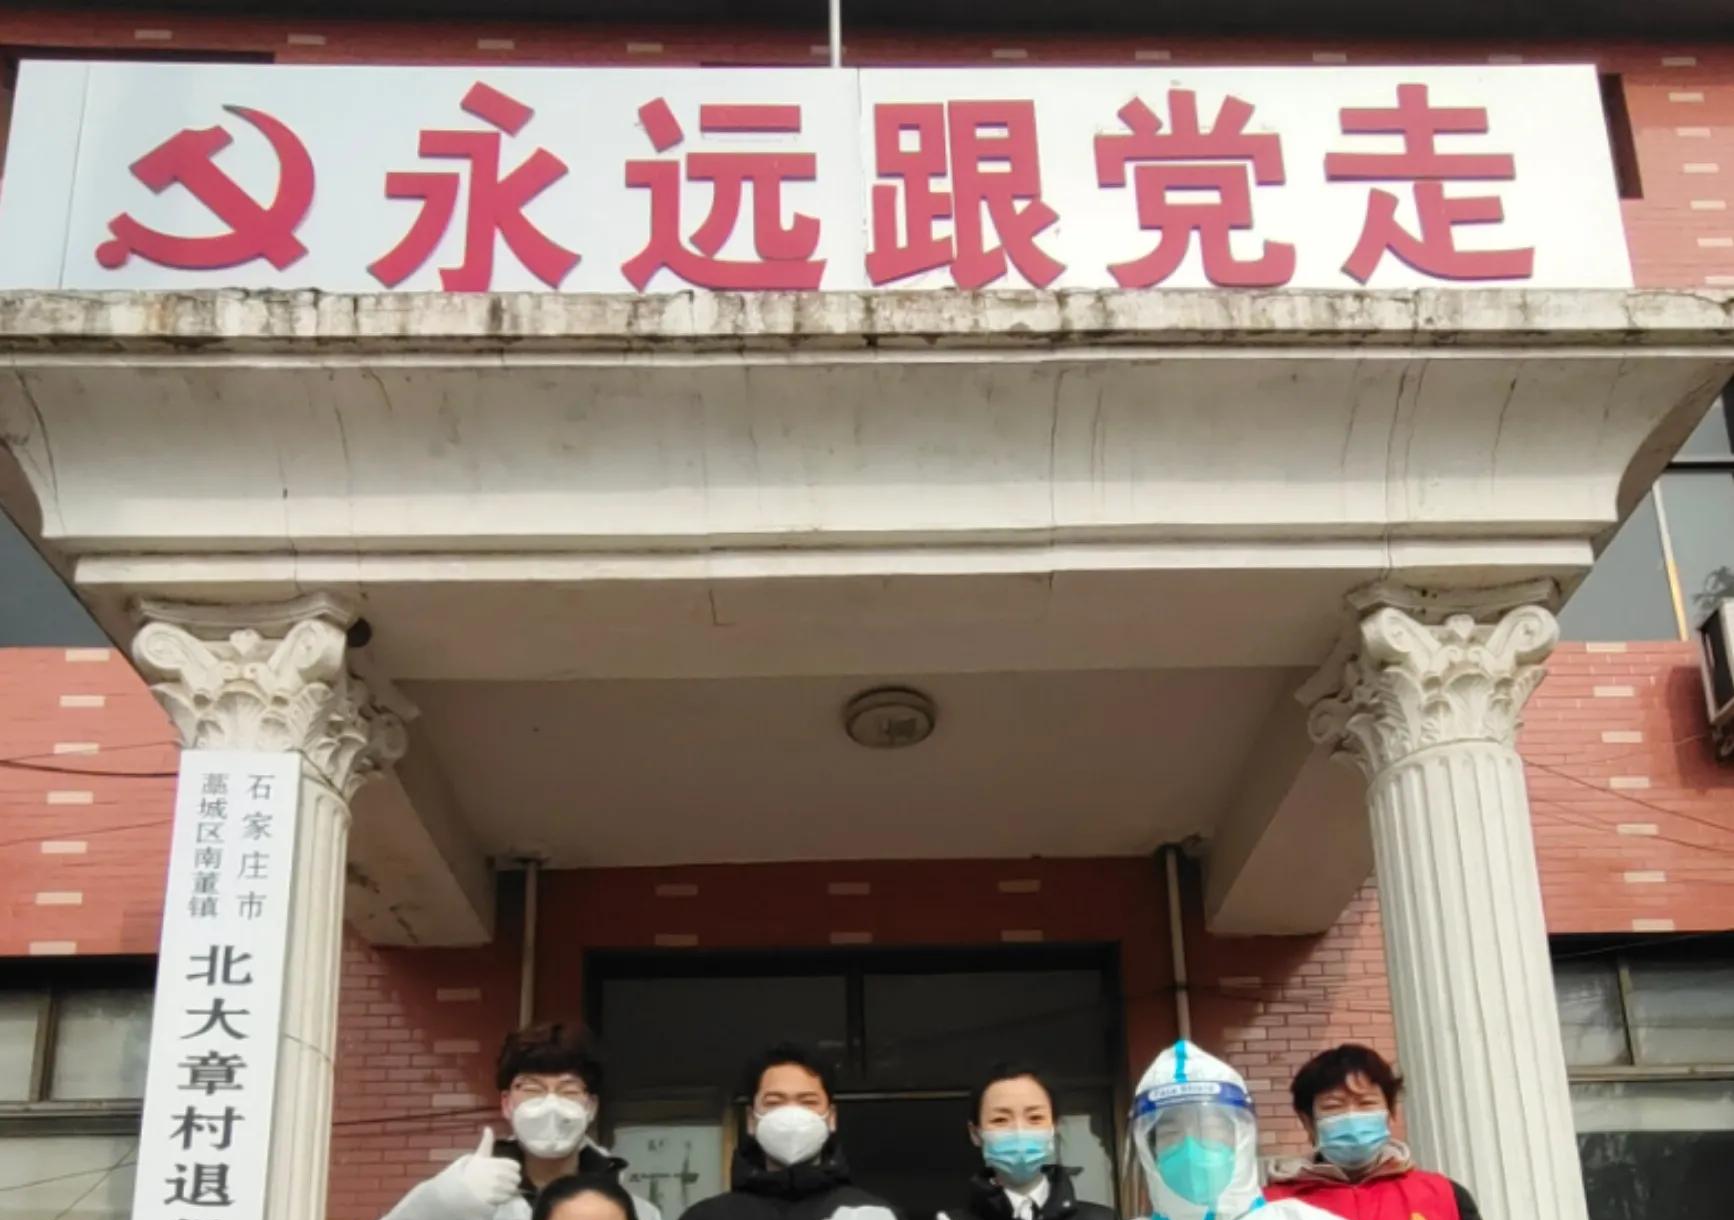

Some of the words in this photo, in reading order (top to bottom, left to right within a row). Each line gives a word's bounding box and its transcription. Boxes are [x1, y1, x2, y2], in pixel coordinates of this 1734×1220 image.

[367, 81, 1535, 292] 永远跟党走
[236, 773, 276, 920] 石家庄市
